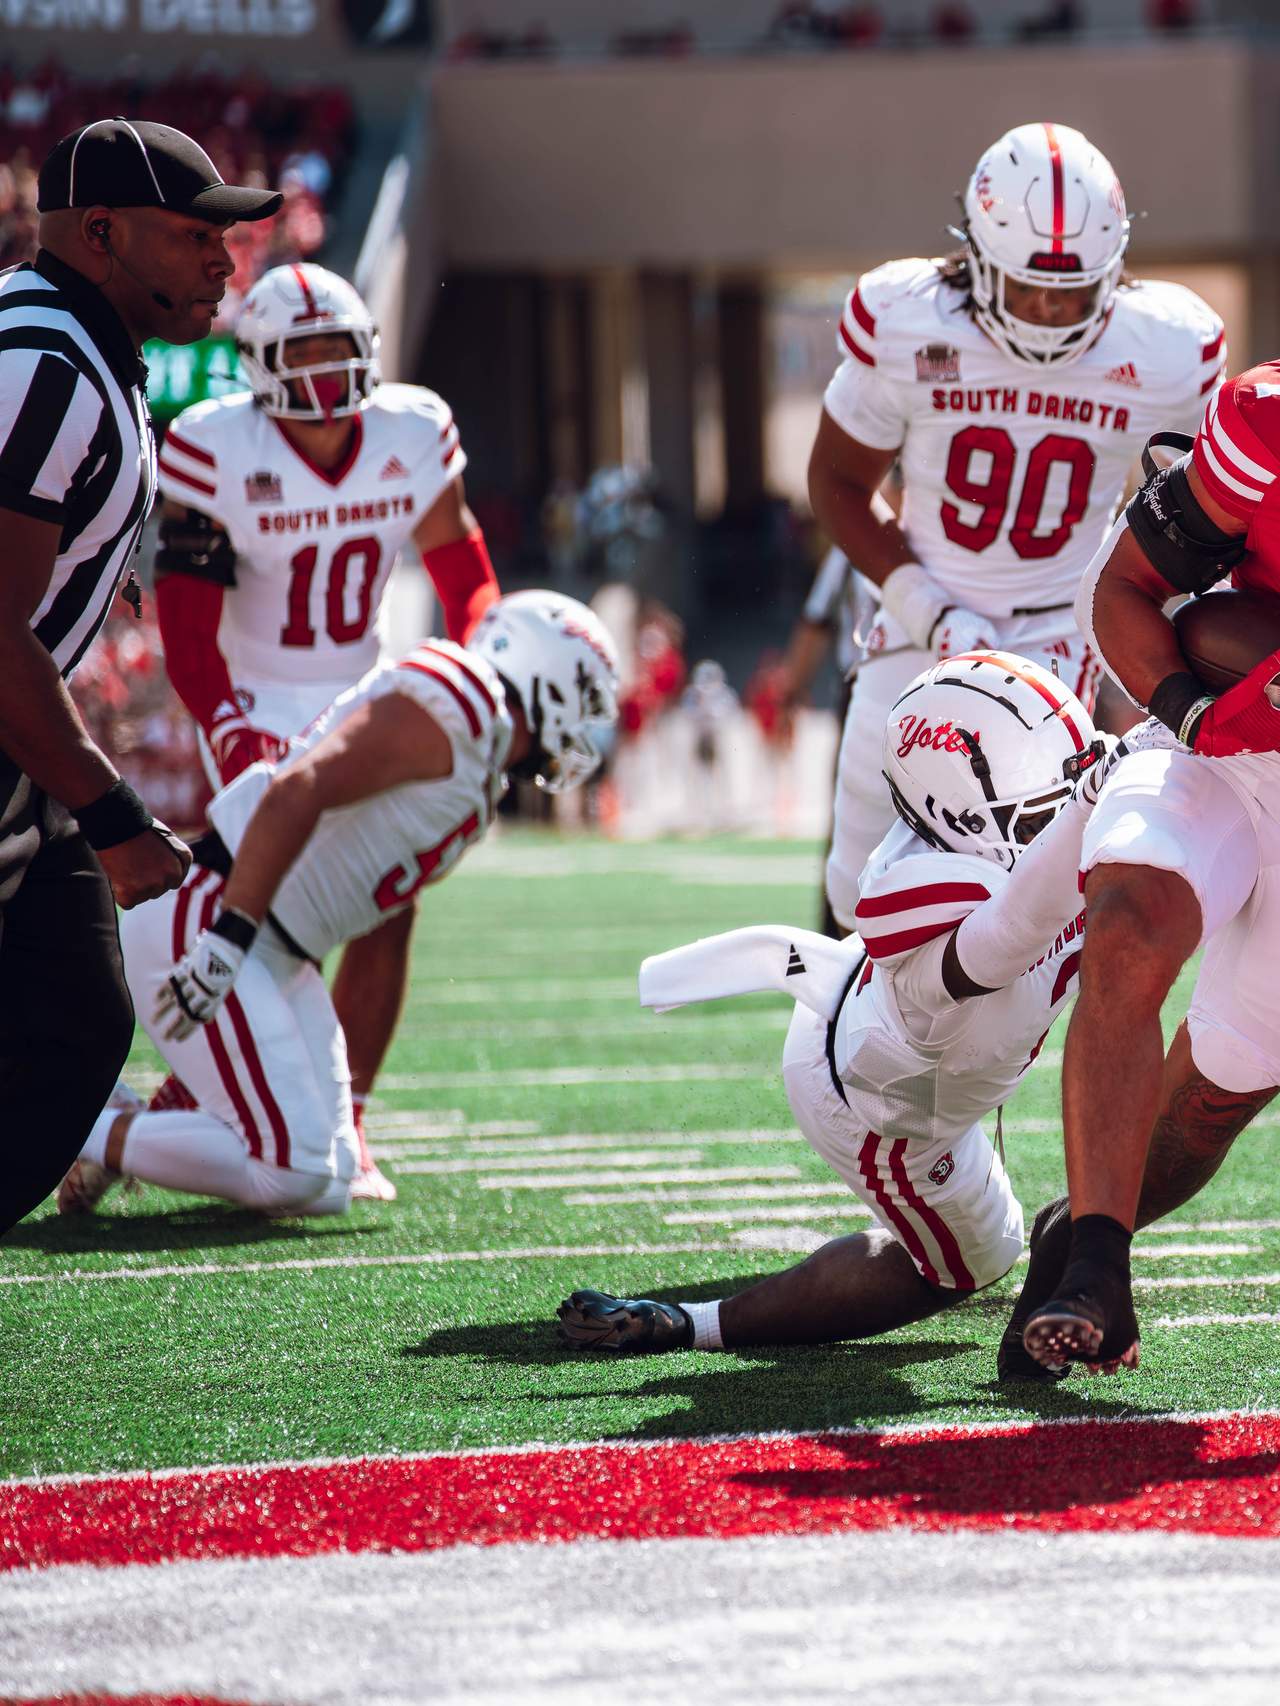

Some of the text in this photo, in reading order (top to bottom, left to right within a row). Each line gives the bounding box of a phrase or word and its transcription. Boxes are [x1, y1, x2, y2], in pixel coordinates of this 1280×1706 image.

[931, 388, 1130, 431] SOUTH DAKOTA
[257, 494, 416, 534] SOUTH DAKOTA
[940, 424, 1097, 559] 90
[280, 535, 382, 648] 10
